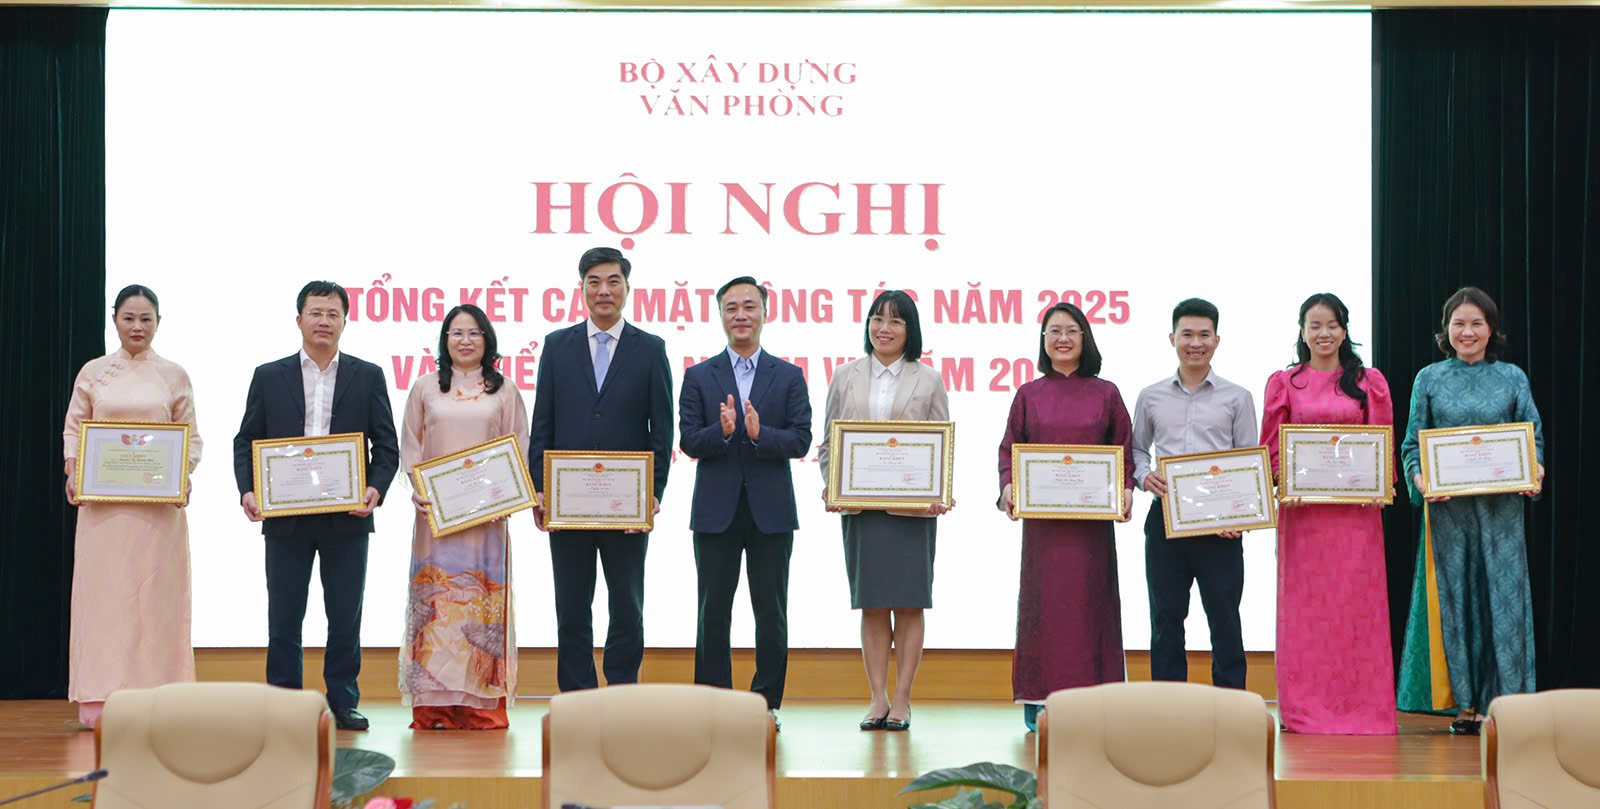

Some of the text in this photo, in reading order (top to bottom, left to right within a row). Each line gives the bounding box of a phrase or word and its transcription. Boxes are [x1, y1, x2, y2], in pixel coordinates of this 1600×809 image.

[619, 54, 857, 90] BỘ XÂY DỰNG
[640, 87, 843, 117] VĂN PHÒNG
[529, 172, 946, 251] HỘI NGHỊ
[343, 273, 446, 322] TỔNG
[459, 276, 529, 322] KẾT
[542, 280, 591, 322] CÁ
[633, 281, 715, 331] MẶT
[763, 281, 833, 324] ÔNG
[933, 282, 1023, 324] NĂM
[989, 357, 1041, 392] 20
